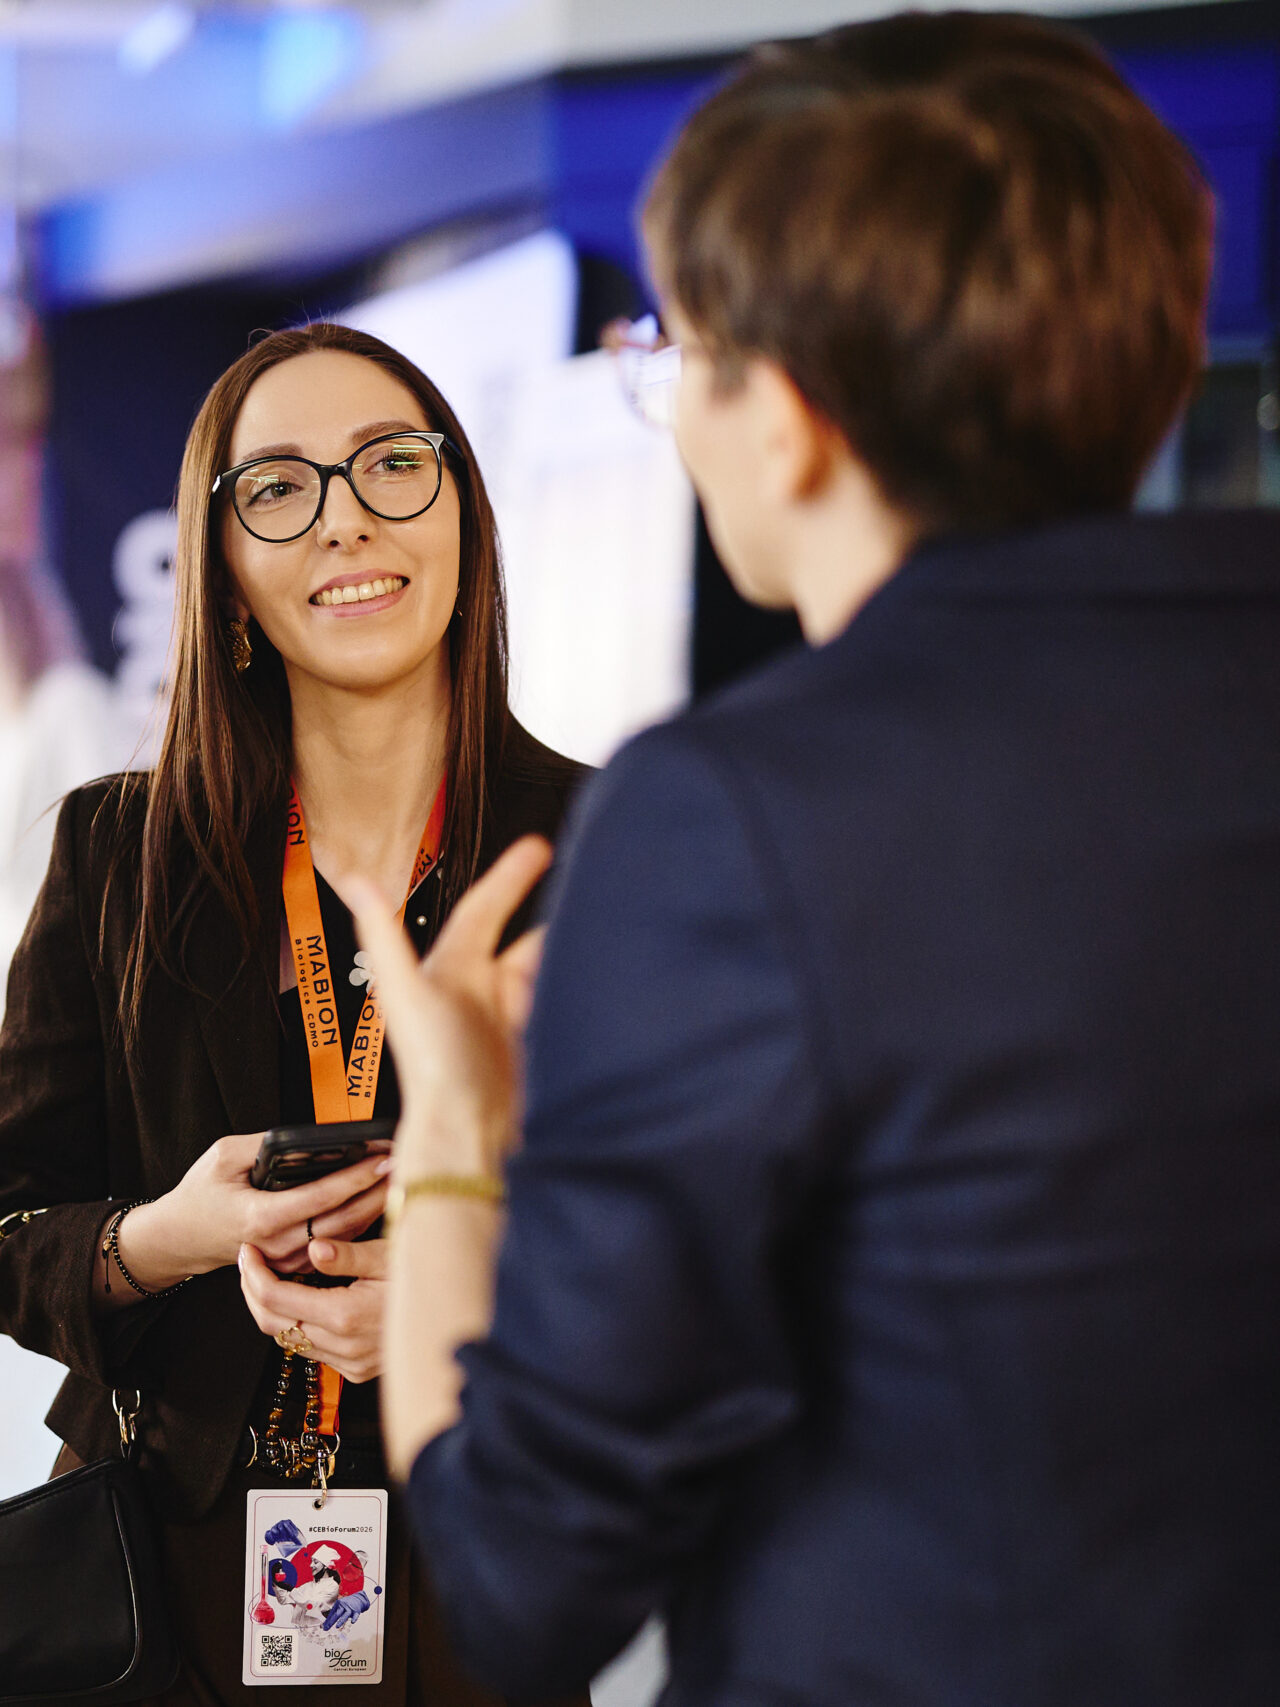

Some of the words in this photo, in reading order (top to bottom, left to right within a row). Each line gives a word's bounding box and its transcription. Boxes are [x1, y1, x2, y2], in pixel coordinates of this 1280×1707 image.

[306, 935, 338, 1046] MABION
[307, 1013, 319, 1048] CDMO
[324, 1648, 341, 1658] bio
